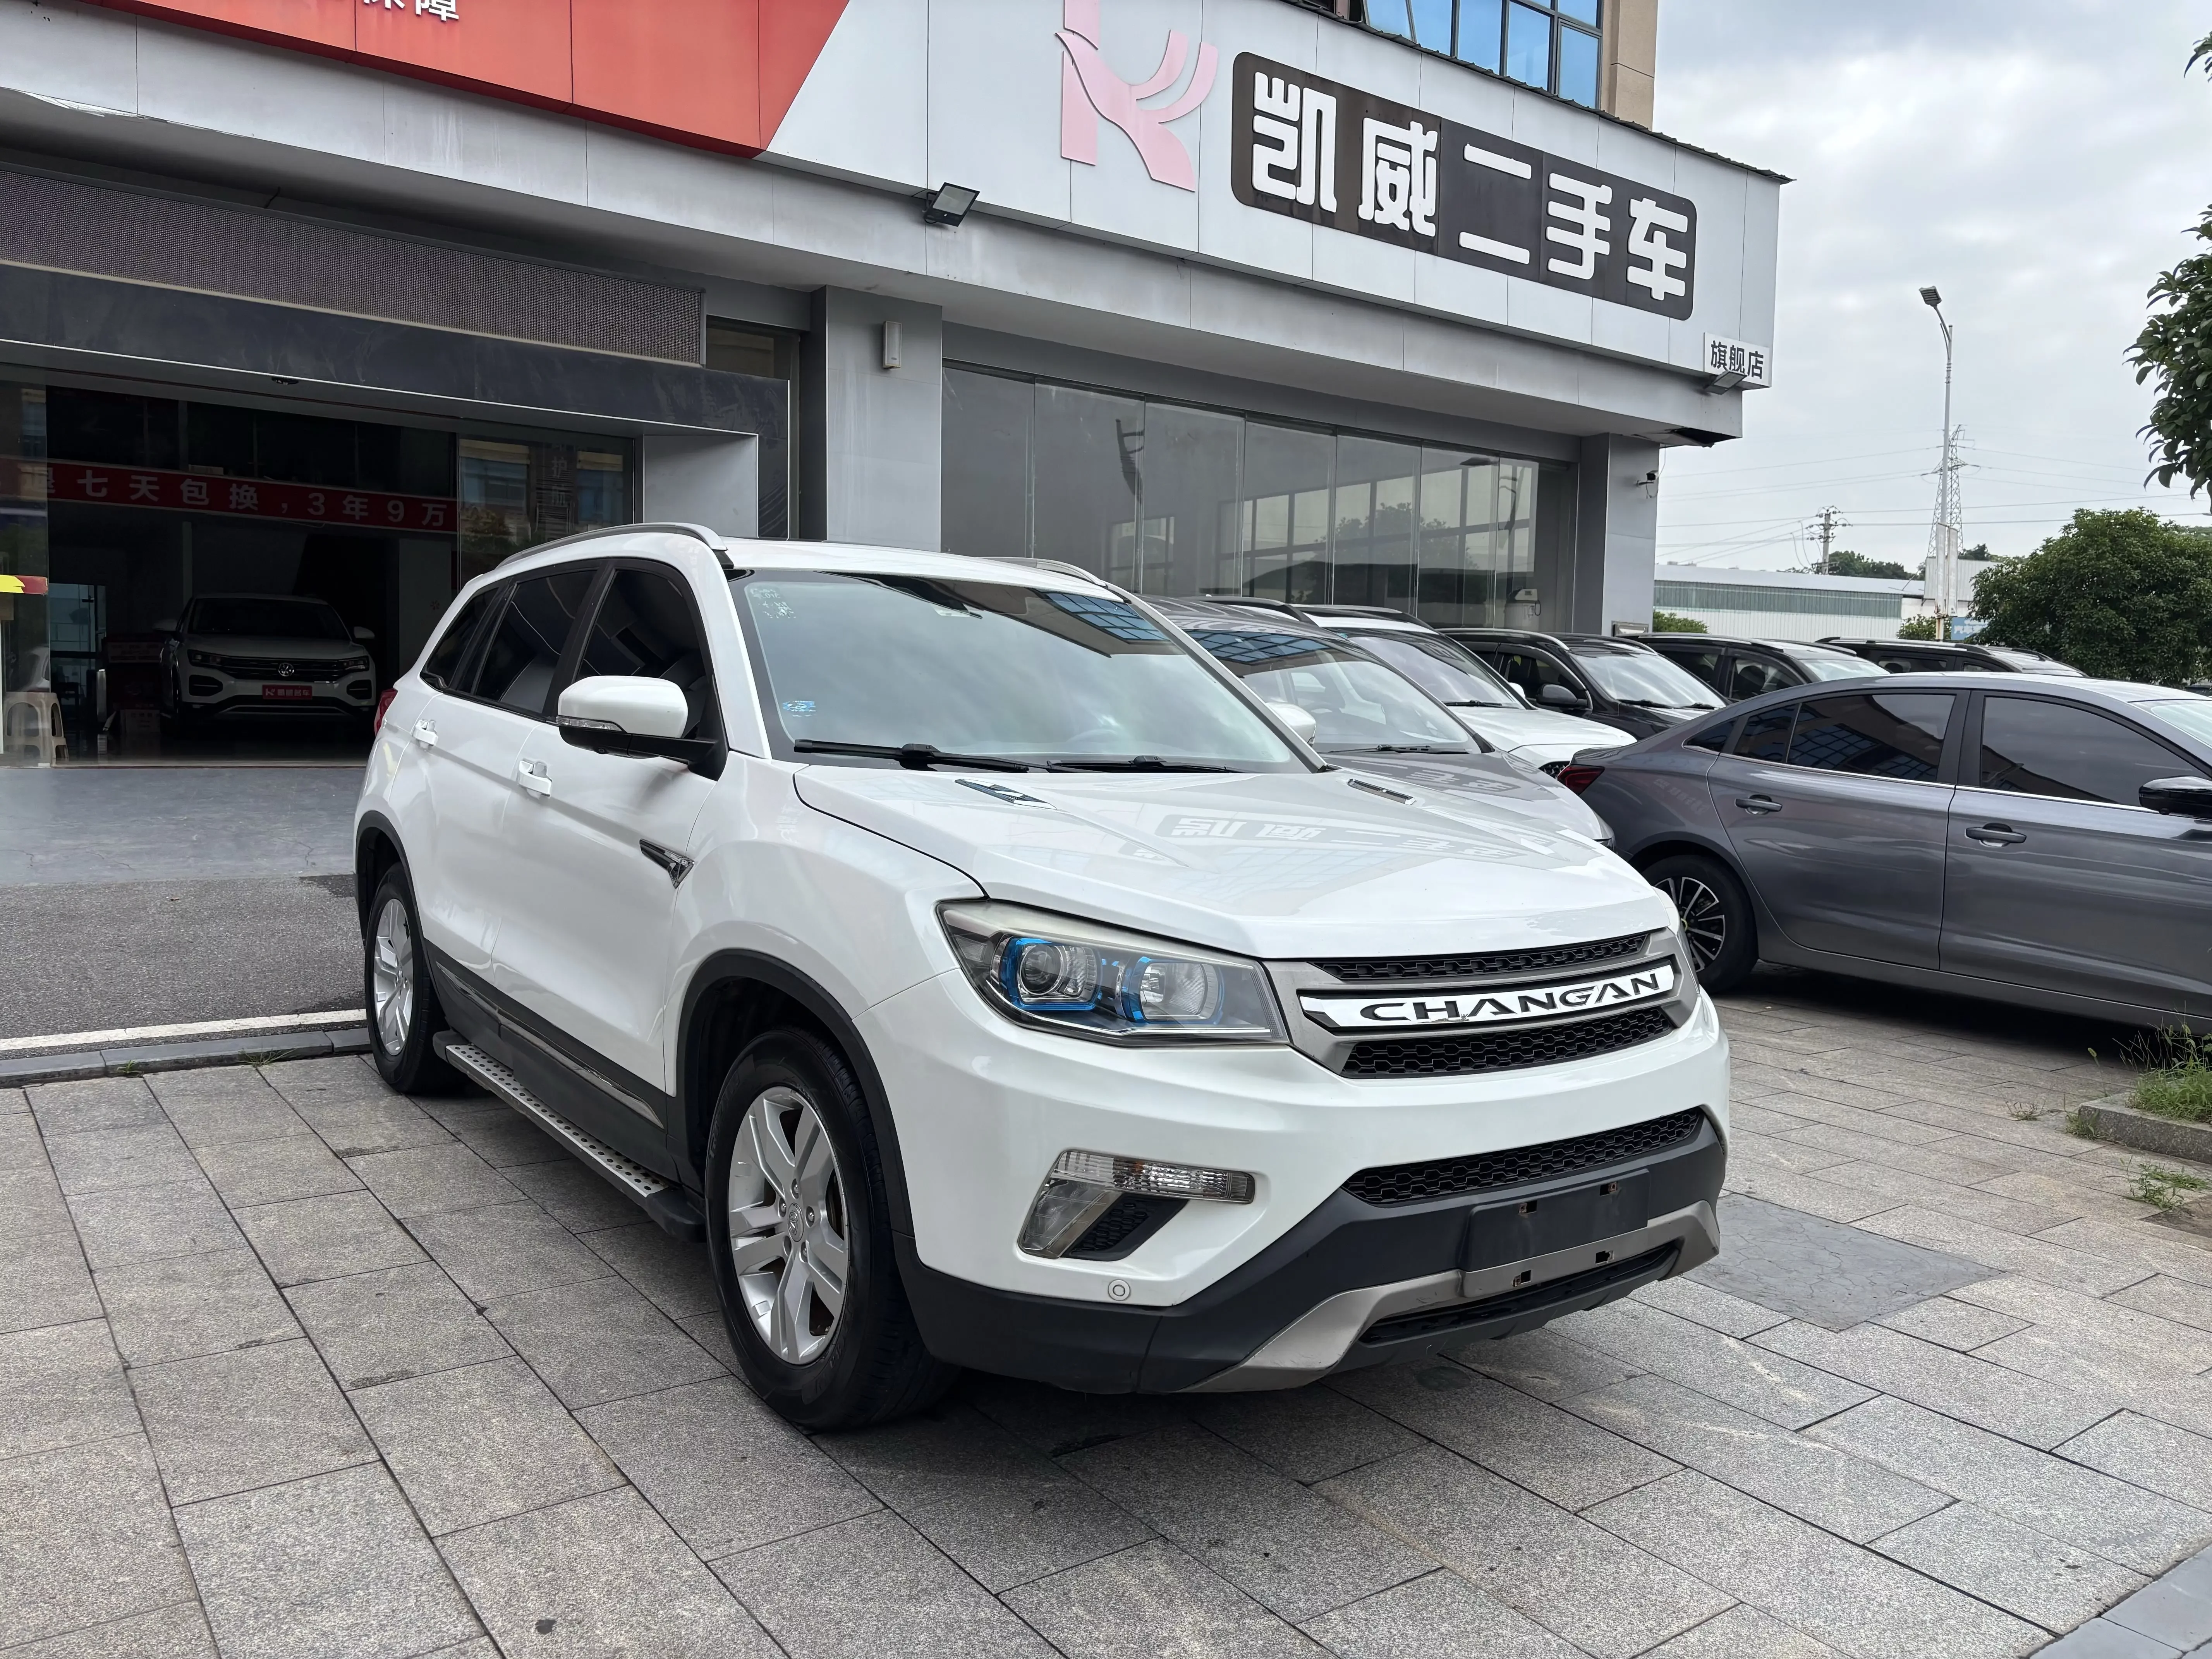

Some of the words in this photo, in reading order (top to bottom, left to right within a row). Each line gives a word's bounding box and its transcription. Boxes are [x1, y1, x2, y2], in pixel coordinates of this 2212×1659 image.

[1252, 71, 1688, 301] 凯威二手车
[1711, 340, 1764, 379] 旗舰店
[1360, 972, 1660, 1021] CHANGAN
